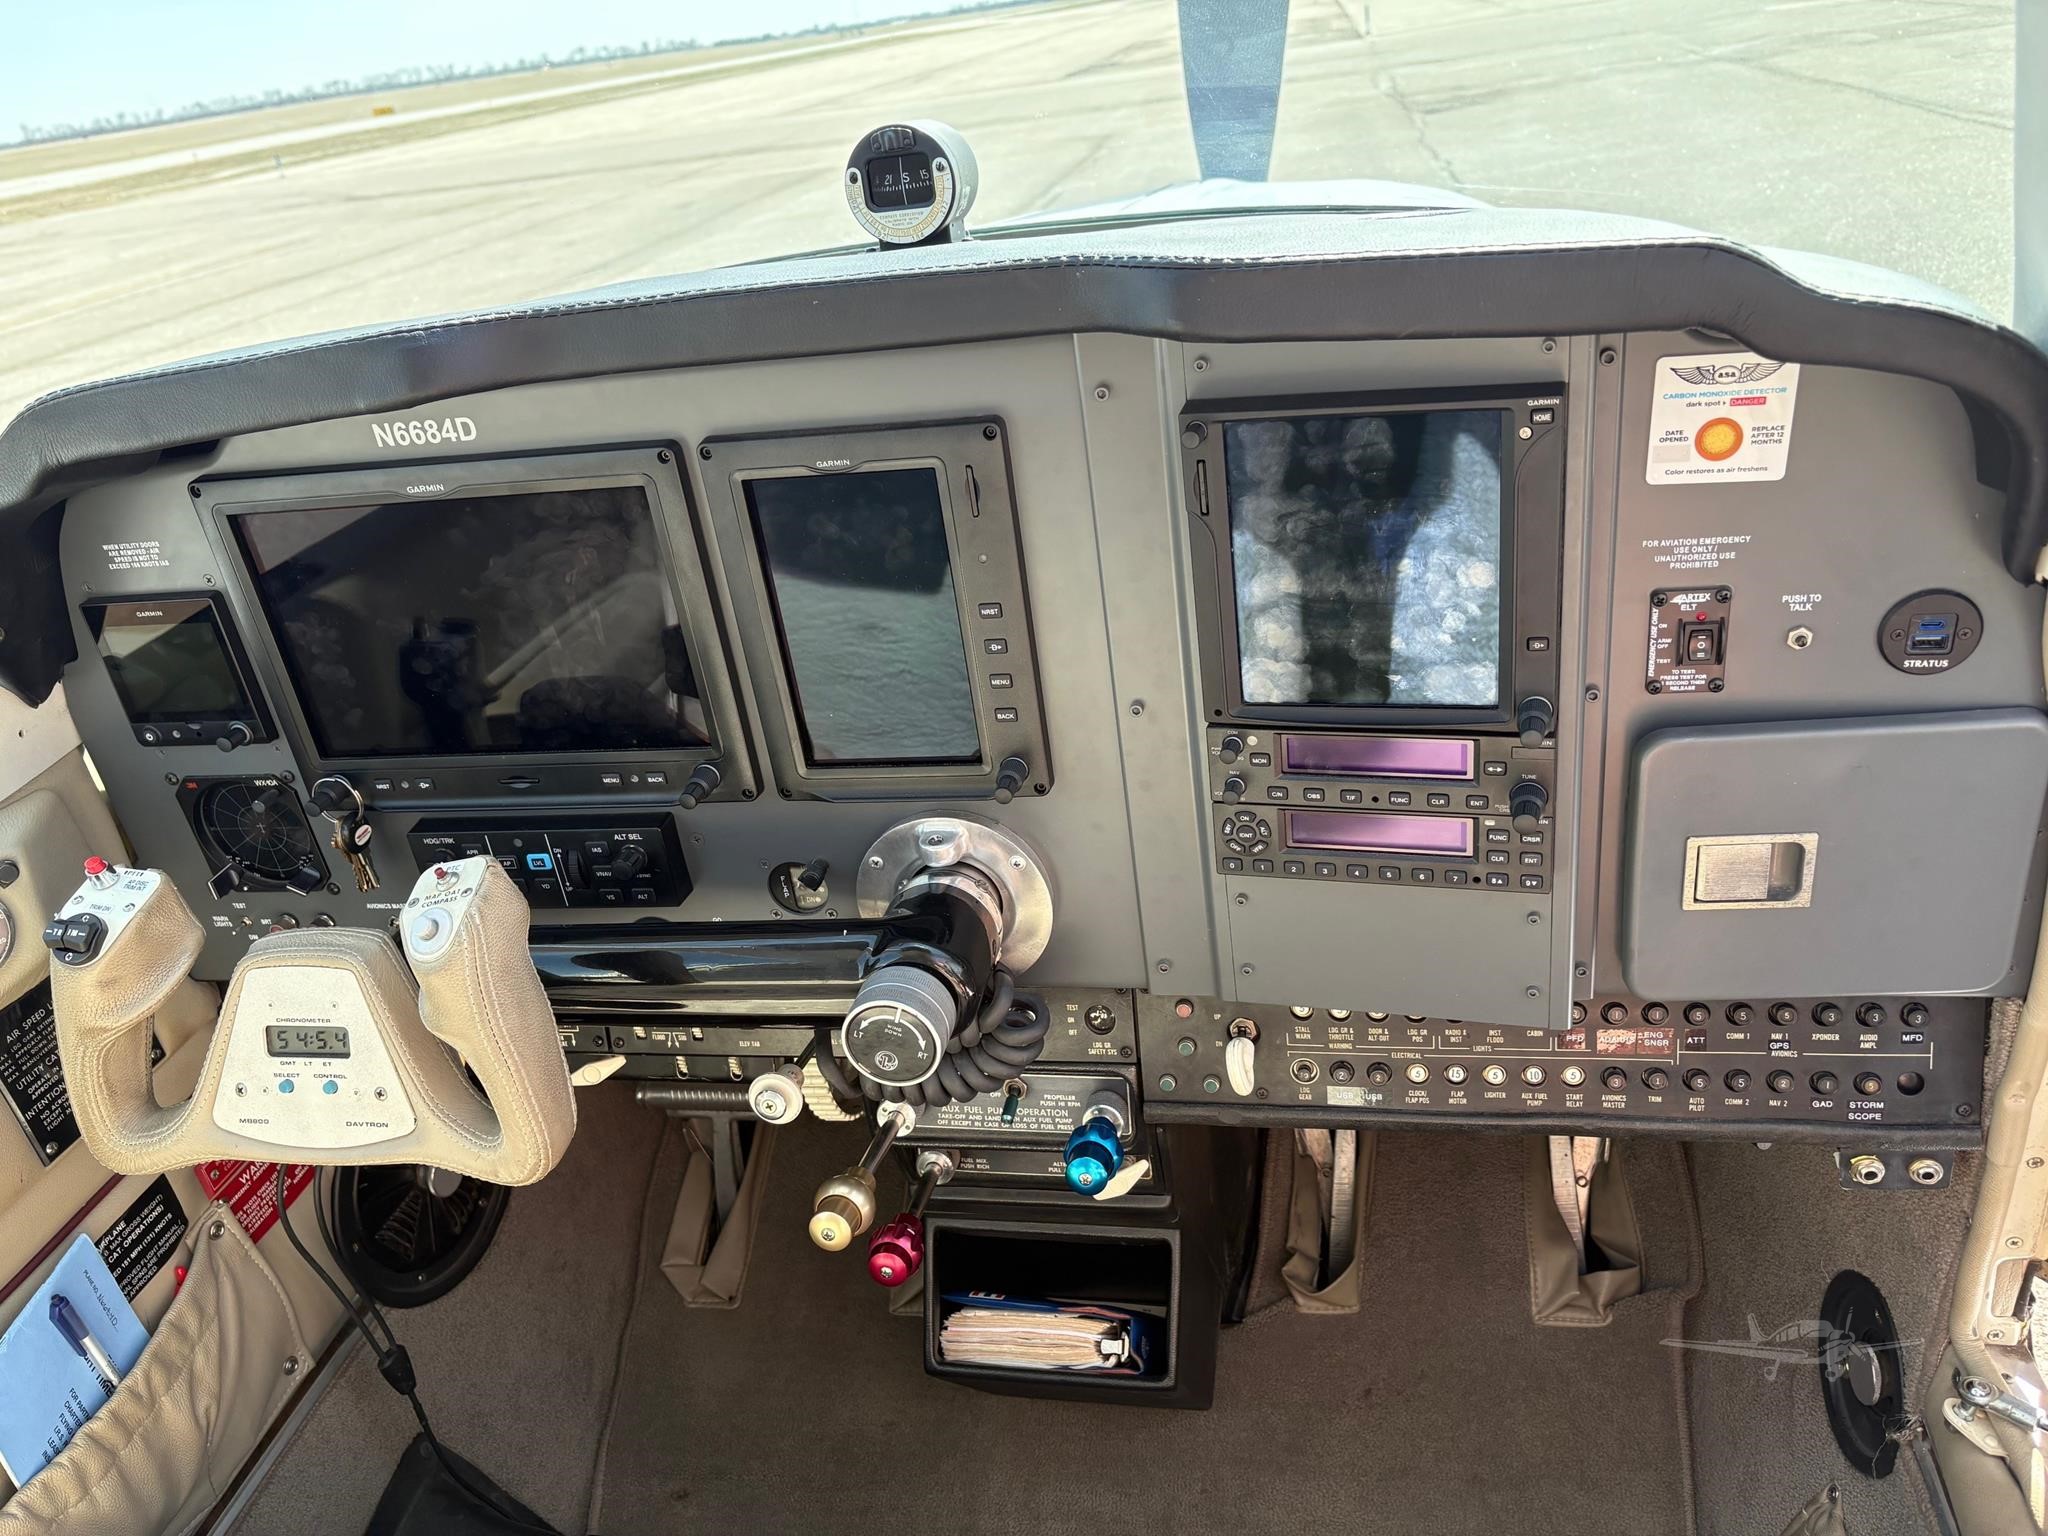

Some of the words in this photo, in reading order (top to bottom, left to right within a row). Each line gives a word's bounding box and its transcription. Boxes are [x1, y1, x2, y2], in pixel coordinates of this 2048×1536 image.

[903, 172, 910, 183] S
[1699, 390, 1742, 398] MONOXIDE
[1743, 386, 1788, 396] DETECTOR
[1527, 398, 1560, 406] GARMIN
[1731, 397, 1766, 406] DANGER
[1533, 413, 1552, 422] HOME
[371, 417, 478, 448] N6684D
[1750, 438, 1783, 446] MONTHS
[816, 459, 850, 468] GARMIN
[1686, 467, 1714, 475] restores
[407, 484, 445, 494] GARMIN
[1642, 540, 1659, 548] FOR
[1660, 538, 1698, 547] AVIATION
[1699, 535, 1751, 545] EMERGENCY
[1674, 546, 1690, 554] USE
[1691, 545, 1713, 553] ONLY
[1654, 553, 1718, 563] UNAUTHORIZED
[1719, 551, 1736, 560] USE
[1669, 560, 1719, 569] PROHIBITED
[1679, 593, 1711, 601] ARTEX
[1782, 594, 1807, 603] PUSH
[1809, 594, 1822, 602] TO
[1789, 603, 1813, 611] TALK
[1648, 639, 1658, 677] EMERGENCY
[1903, 659, 1949, 668] STRATUS
[991, 678, 1010, 686] MENU
[424, 837, 456, 845] HDG/TRK
[628, 833, 643, 841] SEL
[424, 893, 442, 901] MAP
[445, 888, 461, 898] OAT
[421, 895, 459, 909] COMPASS
[6, 1029, 22, 1044] AIR
[22, 1009, 46, 1031] SPEED
[887, 1024, 903, 1032] WING
[853, 1030, 864, 1039] LT
[884, 1028, 903, 1038] DOWN
[1644, 1031, 1663, 1039] ENG
[1811, 1033, 1840, 1041] XPONDER
[1902, 1034, 1923, 1042] MFD
[1769, 1042, 1790, 1050] GPS
[1859, 1041, 1877, 1049] AMPL
[917, 1052, 928, 1061] RT
[1771, 1050, 1798, 1058] AVIONICS
[16, 1064, 45, 1090] UTILITY
[1044, 1094, 1077, 1102] PROPELLER
[1534, 1092, 1548, 1100] FUEL
[1601, 1094, 1627, 1102] AVIONICS
[1448, 1097, 1467, 1105] MOTOR
[1602, 1101, 1625, 1109] MASTER
[1769, 1099, 1782, 1107] NAV
[1812, 1100, 1833, 1108] GAD
[1848, 1101, 1884, 1109] STORM
[941, 1105, 961, 1113] AUX
[963, 1105, 985, 1114] FUEL
[1016, 1107, 1070, 1117] OPERATION
[1688, 1104, 1705, 1112] PILOT
[937, 1113, 968, 1121] TAKE-OFF
[1847, 1112, 1882, 1120] SCOPE
[346, 1120, 389, 1129] DAVTRON
[124, 1204, 165, 1248] OPERATIONS)
[110, 1238, 123, 1251] MAX
[122, 1217, 141, 1237] GROSS
[131, 1244, 143, 1259] MPH
[155, 1213, 173, 1233] KNOTS
[140, 1244, 159, 1266] FLIGHT
